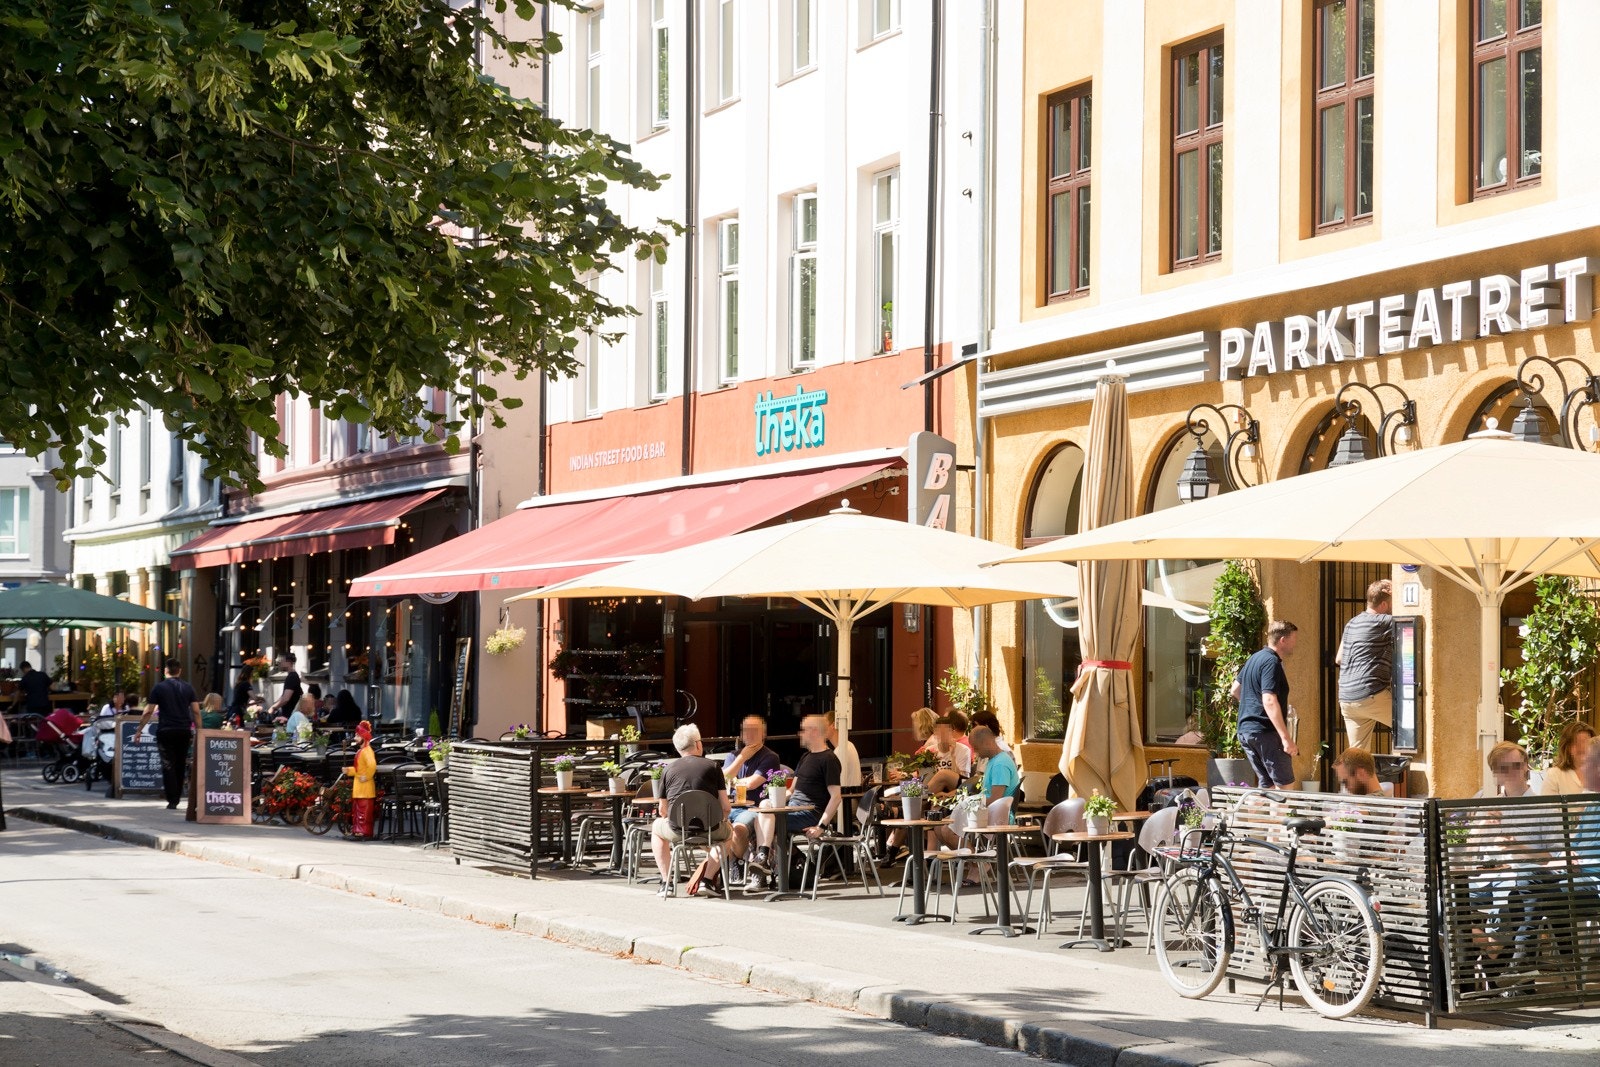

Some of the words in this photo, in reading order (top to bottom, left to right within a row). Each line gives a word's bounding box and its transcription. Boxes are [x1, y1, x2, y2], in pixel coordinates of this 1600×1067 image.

[1219, 256, 1592, 382] PARKTEATRET
[754, 384, 828, 457] theka
[569, 453, 594, 472] INDIAN
[594, 448, 621, 468] STREET
[621, 444, 643, 464] FOOD
[643, 443, 649, 460] &
[649, 441, 666, 459] BAR
[923, 452, 953, 530] BA
[1404, 586, 1415, 603] 11
[210, 740, 237, 749] DAGENS
[210, 753, 222, 761] VEG
[206, 791, 241, 804] theka
